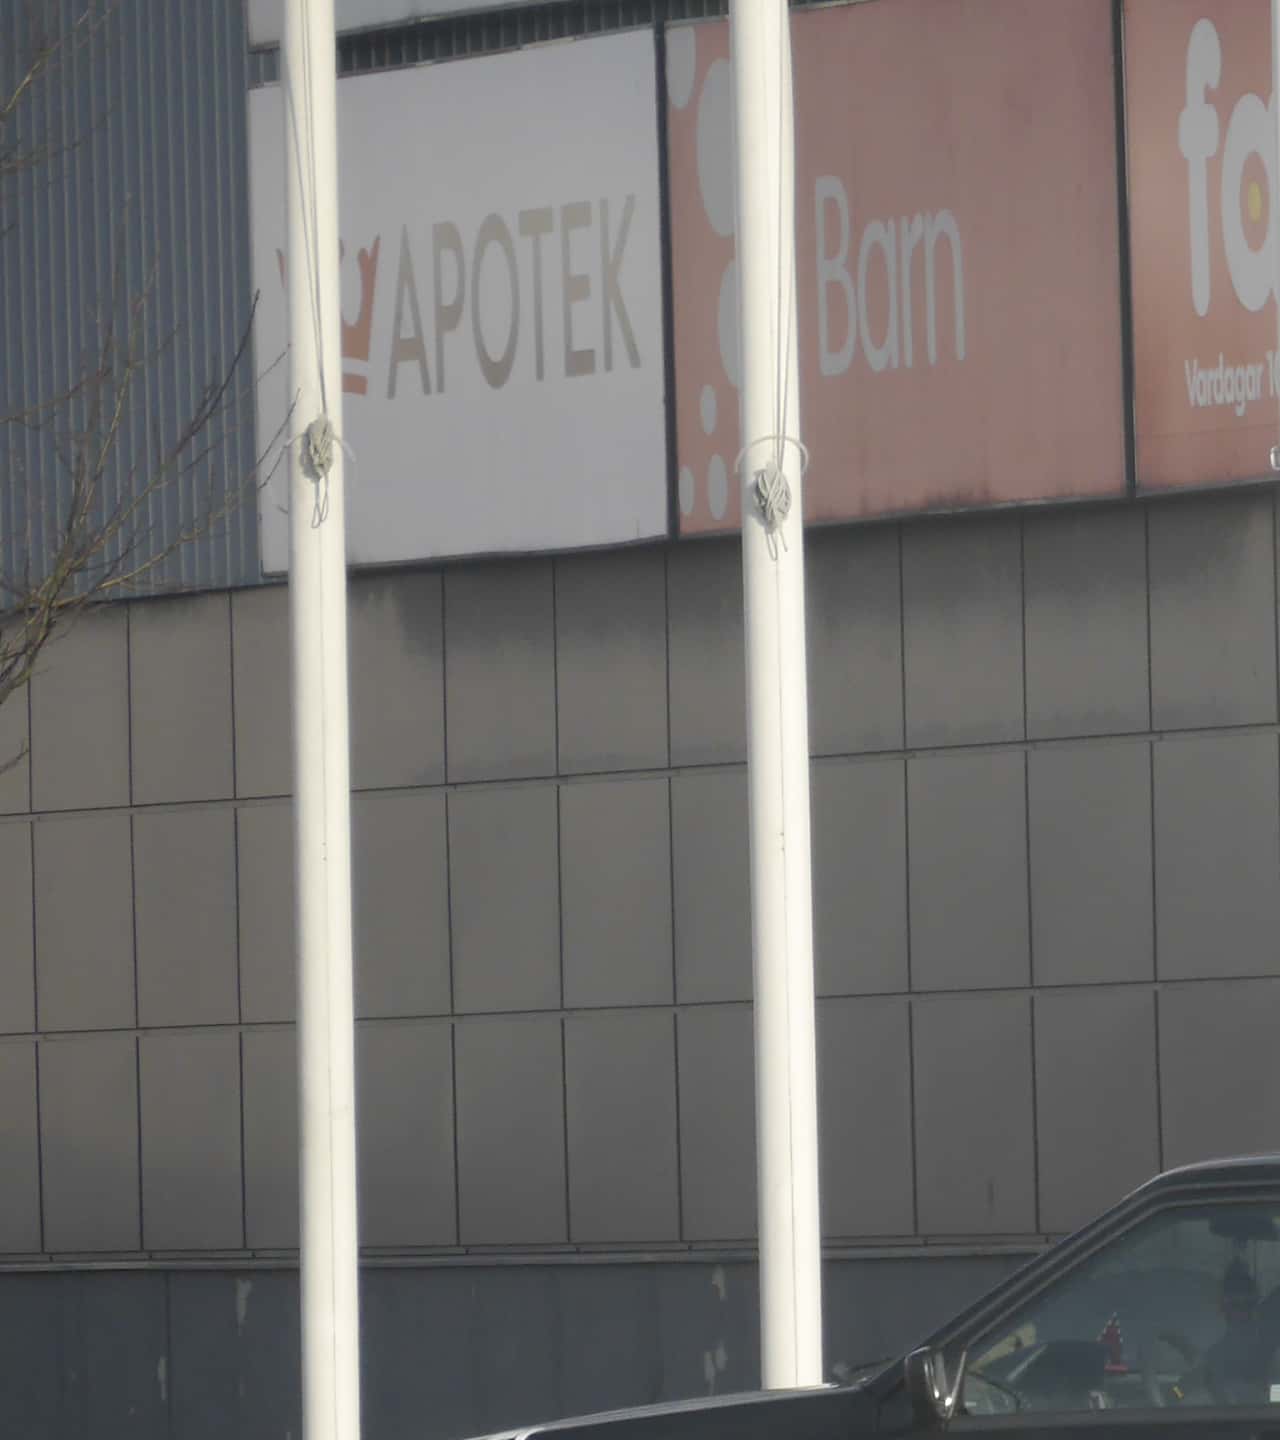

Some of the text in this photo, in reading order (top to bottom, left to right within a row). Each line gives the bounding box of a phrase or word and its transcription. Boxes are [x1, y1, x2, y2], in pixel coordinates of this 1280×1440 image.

[387, 195, 641, 399] APOTEK
[814, 175, 966, 377] Barn
[1184, 352, 1264, 417] Vardagar
